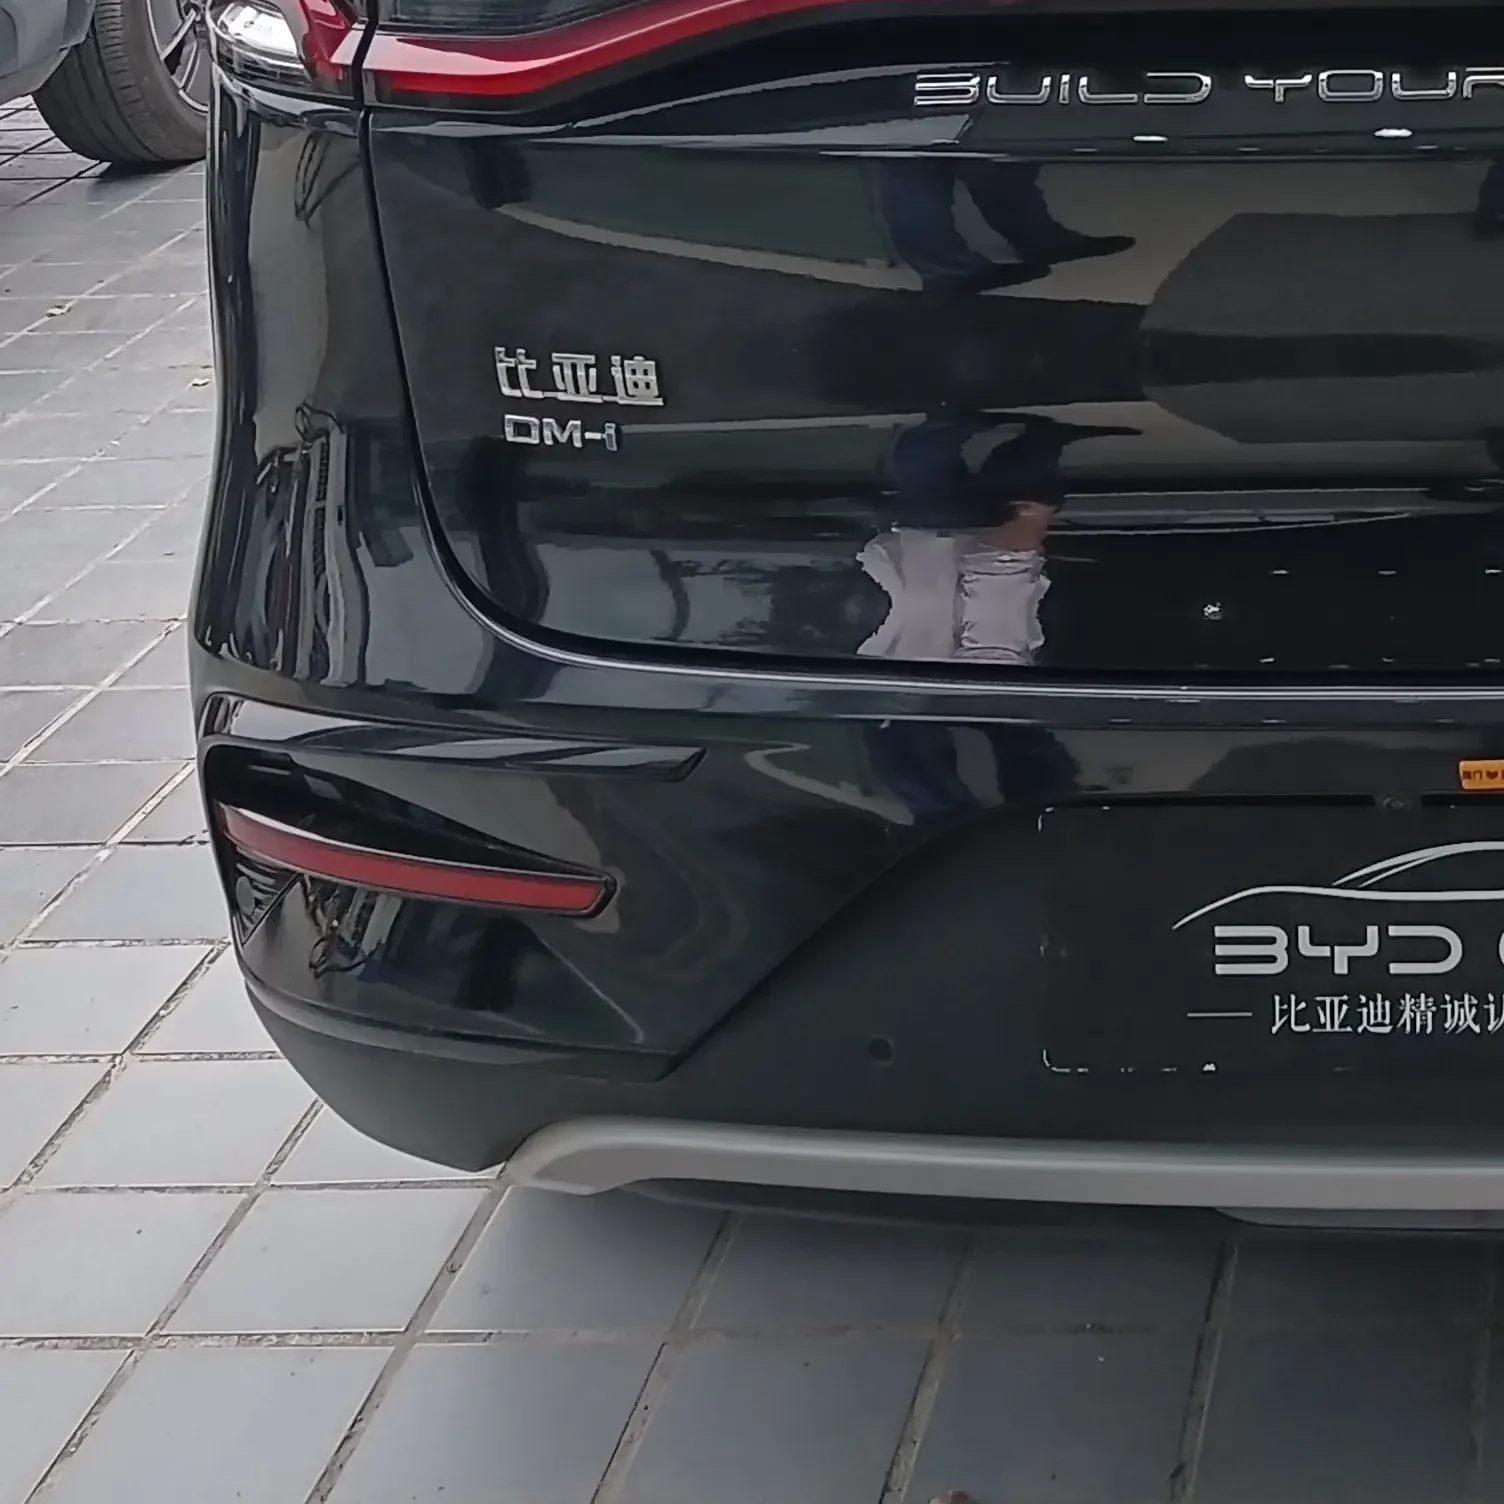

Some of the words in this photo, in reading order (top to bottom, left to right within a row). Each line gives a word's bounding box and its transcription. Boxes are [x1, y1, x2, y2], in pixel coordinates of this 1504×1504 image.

[914, 72, 1213, 106] BUILD
[494, 346, 664, 406] 比亚迪
[504, 413, 618, 451] DM-i
[1214, 925, 1463, 975] BYD
